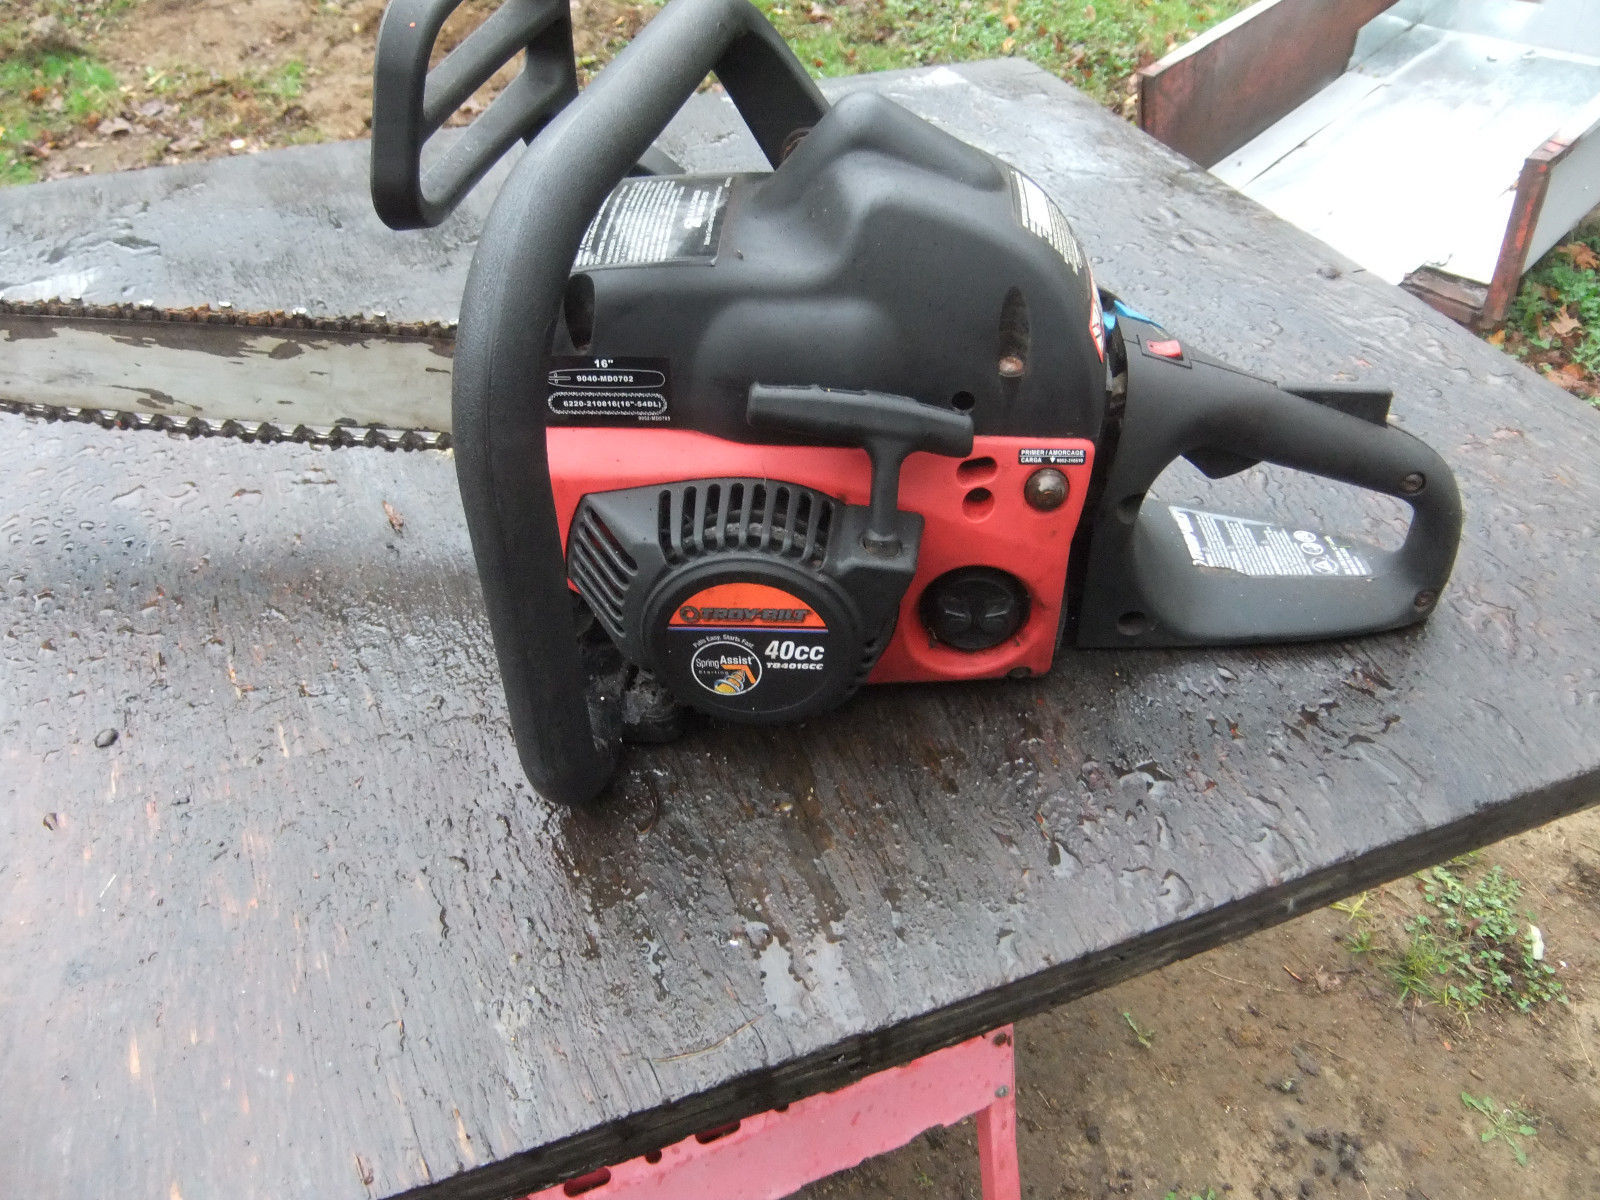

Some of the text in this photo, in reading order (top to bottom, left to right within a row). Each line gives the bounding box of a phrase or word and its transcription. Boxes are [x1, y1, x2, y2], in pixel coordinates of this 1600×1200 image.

[594, 359, 613, 368] 16"
[764, 640, 825, 661] 40cc
[696, 654, 753, 669] Spring Assist
